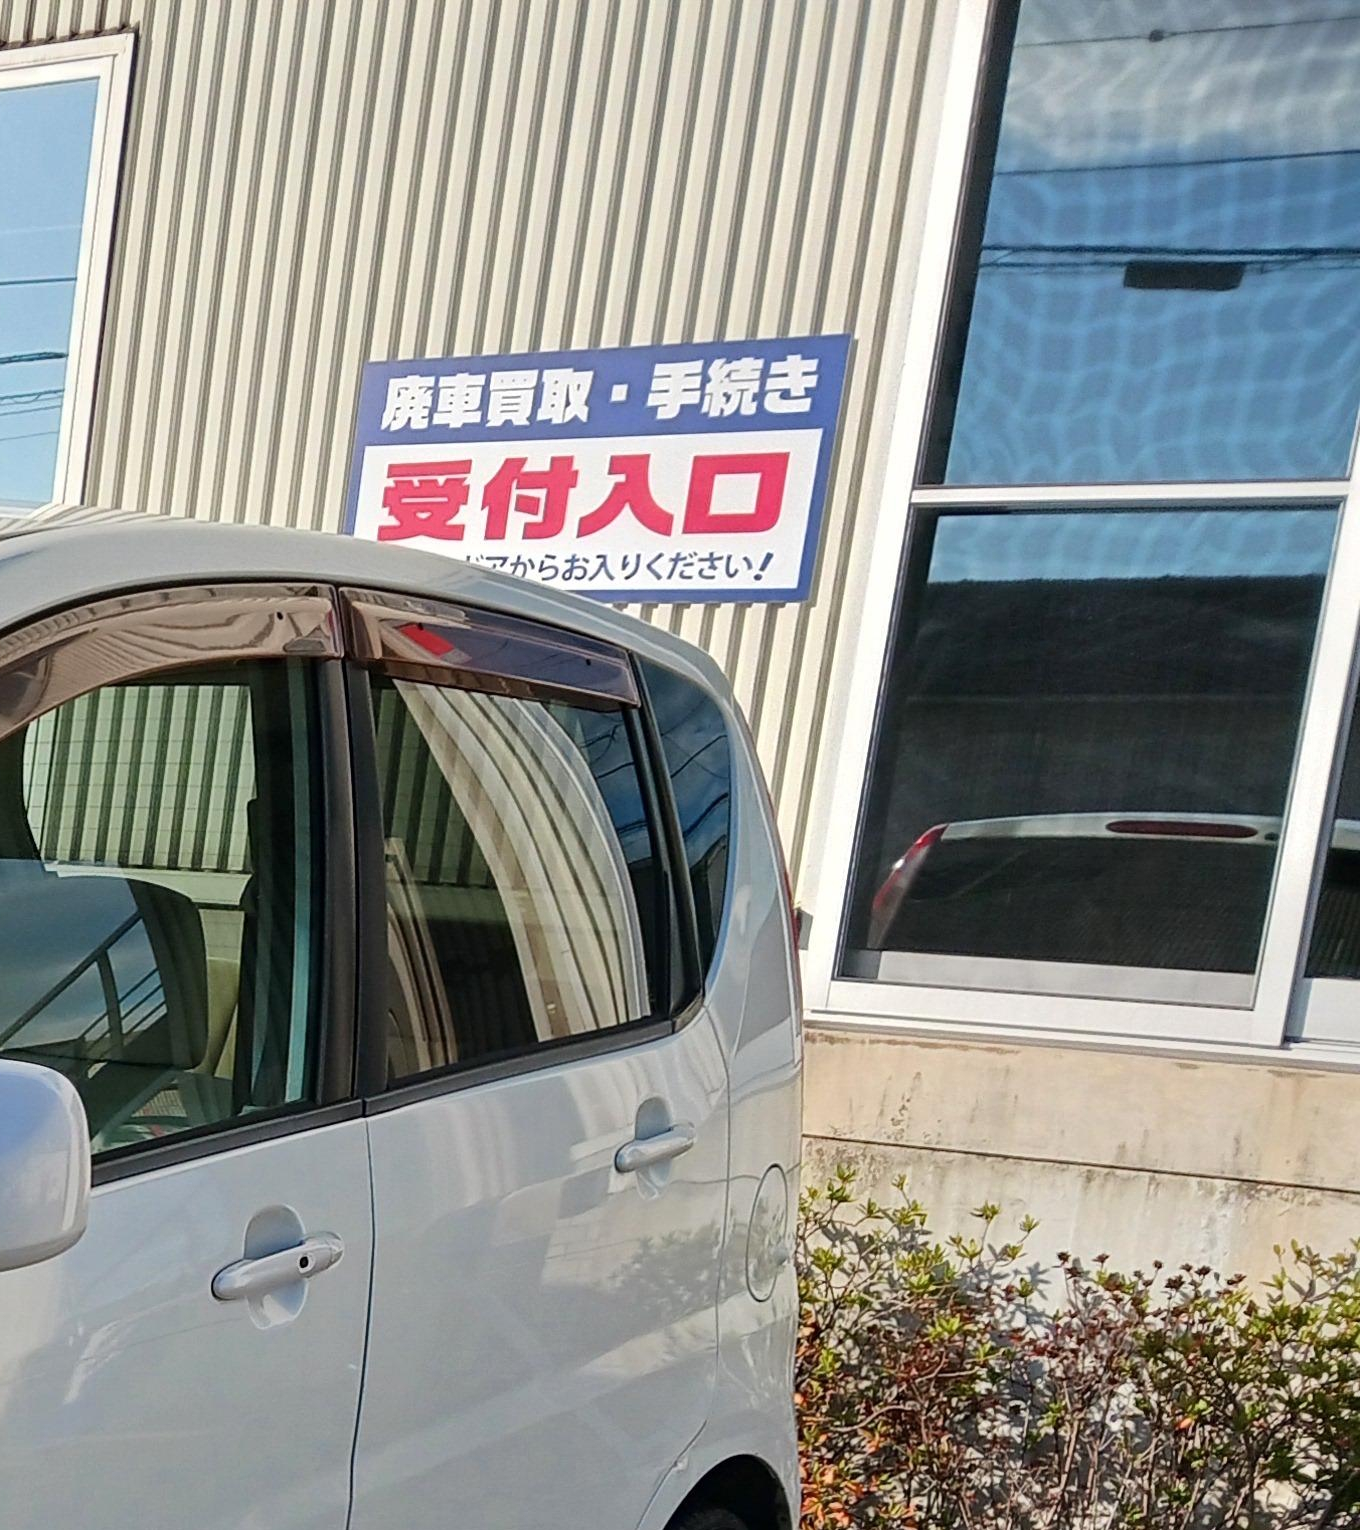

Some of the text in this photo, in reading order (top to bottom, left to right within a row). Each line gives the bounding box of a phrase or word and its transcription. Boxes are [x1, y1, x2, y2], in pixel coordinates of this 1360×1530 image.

[381, 354, 819, 431] 廃車買取・手続き
[376, 450, 791, 542] 受付入口
[466, 552, 773, 581] アからお入りください!
